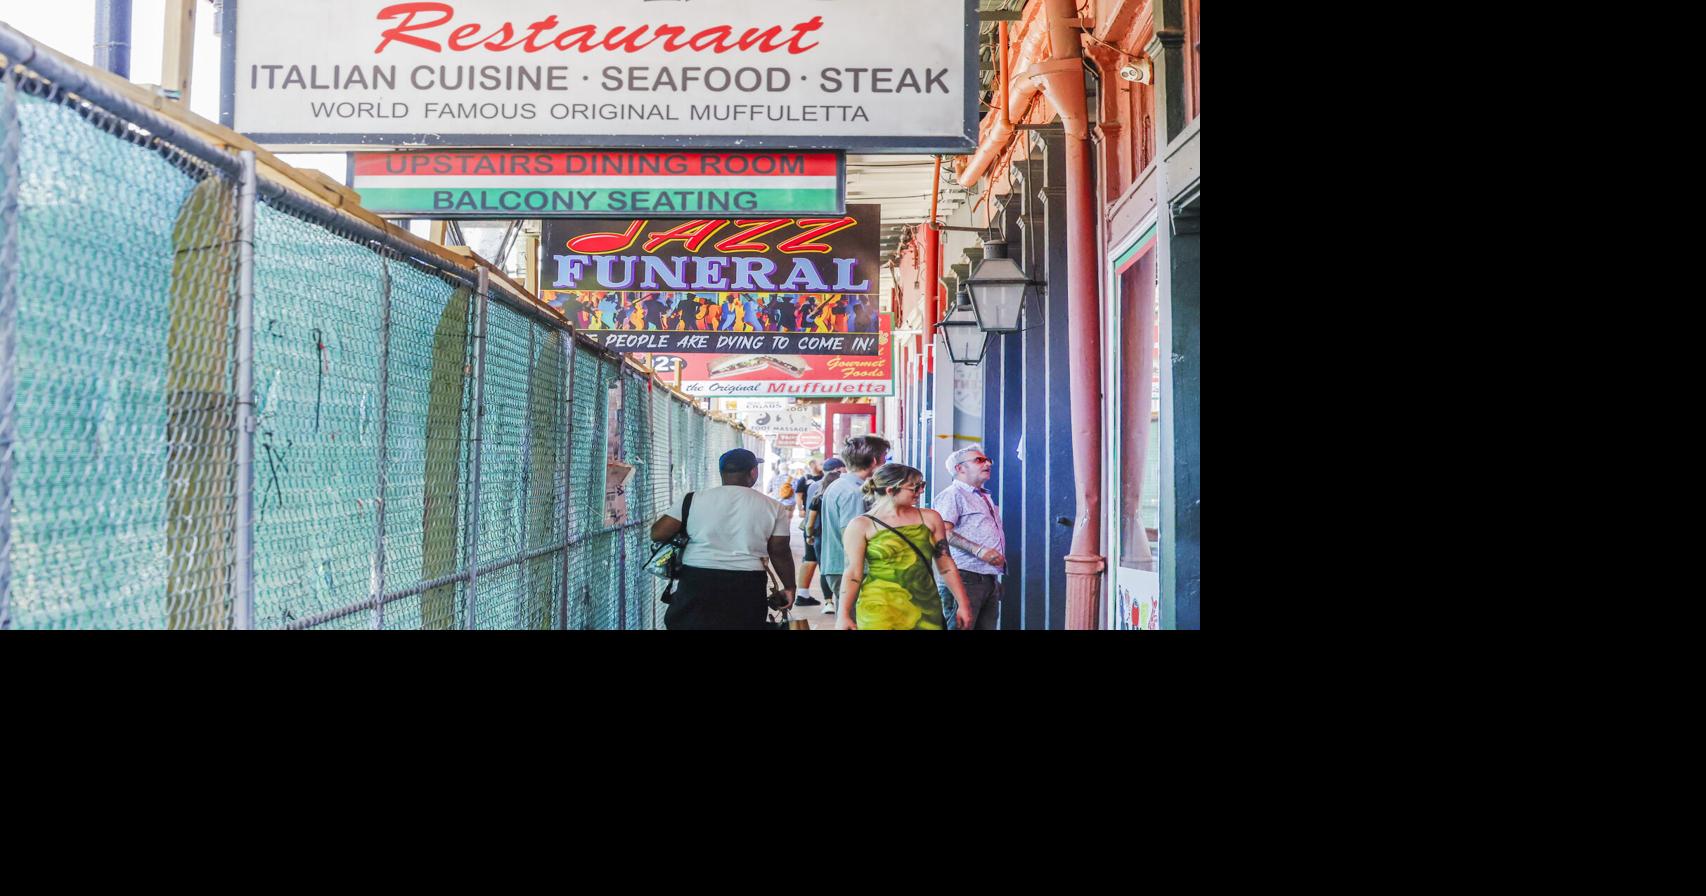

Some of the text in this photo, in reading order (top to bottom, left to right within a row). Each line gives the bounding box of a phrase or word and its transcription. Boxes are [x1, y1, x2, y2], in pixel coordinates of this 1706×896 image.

[374, 2, 824, 54] Restaurant
[250, 64, 950, 94] ITALIAN CUISINE SEAFOOD STEAK
[311, 101, 870, 122] WORLD FAMOUS ORIGINAL MUFFULETTA
[385, 154, 806, 175] UPSTAIRS DINING ROOM
[433, 190, 758, 212] BALCONY SEATING
[566, 216, 857, 255] JAZZ
[552, 254, 870, 292] FUNERAL
[605, 334, 670, 349] PEOPLE
[677, 335, 710, 349] ARE
[716, 335, 765, 350] DYING
[772, 336, 790, 350] TO
[798, 336, 845, 351] COME
[851, 337, 875, 351] IN!
[826, 355, 886, 371] Gourmet
[841, 367, 885, 379] Foods
[686, 382, 886, 395] the Original Muffuletta
